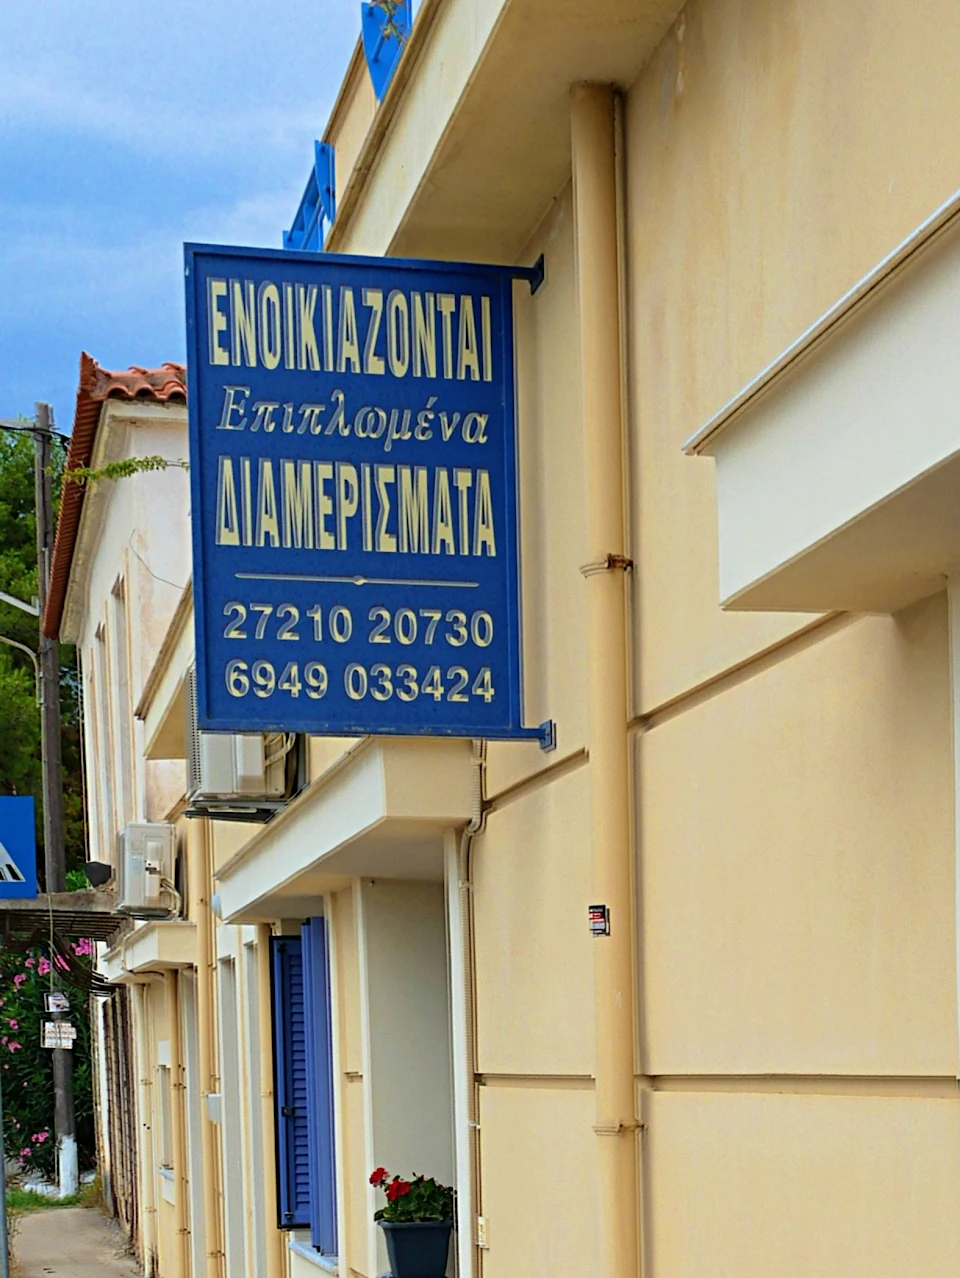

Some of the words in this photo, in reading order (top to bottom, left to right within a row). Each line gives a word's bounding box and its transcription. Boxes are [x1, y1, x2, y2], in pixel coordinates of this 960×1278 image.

[206, 276, 493, 382] ΕΝΟΙΚΙΑΖΟΝΤΑΙ
[216, 384, 489, 452] Επιπλωμένα
[215, 455, 496, 557] ΔΙΑΜΕΡΙΣΜΑΤΑ
[222, 601, 354, 644] 27210
[367, 608, 494, 648] 20730
[224, 659, 329, 699] 6949
[343, 663, 495, 703] 033424
